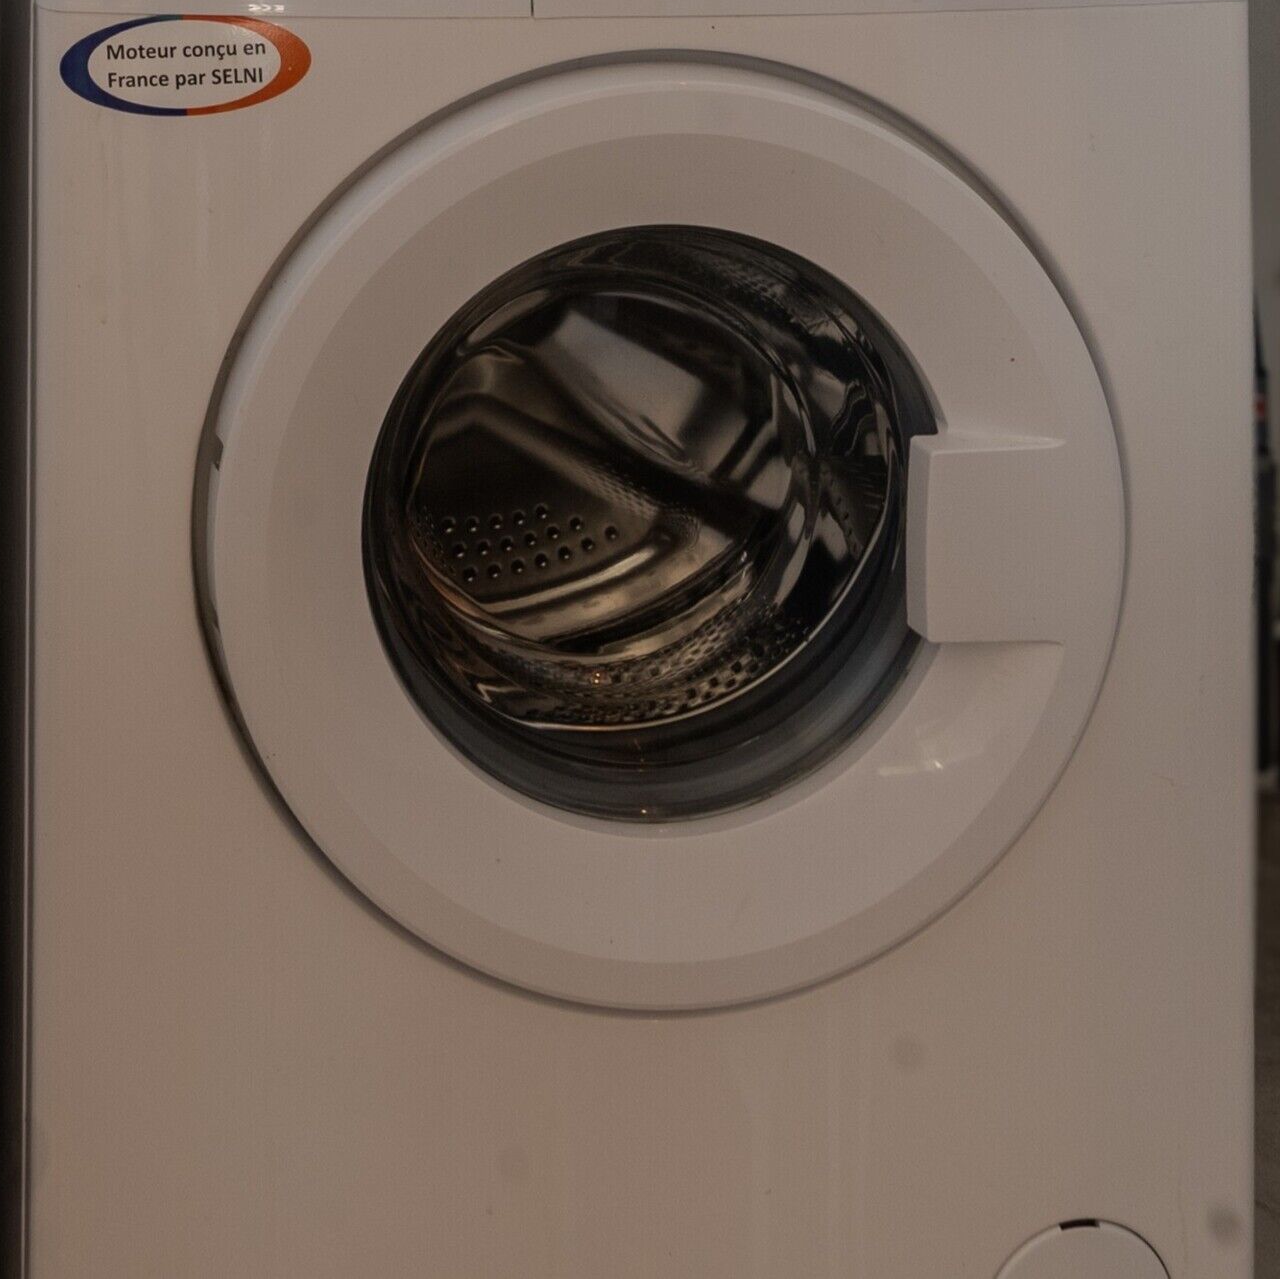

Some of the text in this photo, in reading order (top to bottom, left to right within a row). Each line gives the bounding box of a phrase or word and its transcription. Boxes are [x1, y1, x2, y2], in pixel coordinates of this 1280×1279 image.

[106, 42, 266, 63] Moteur conçu en
[108, 67, 264, 91] France par SELNI
